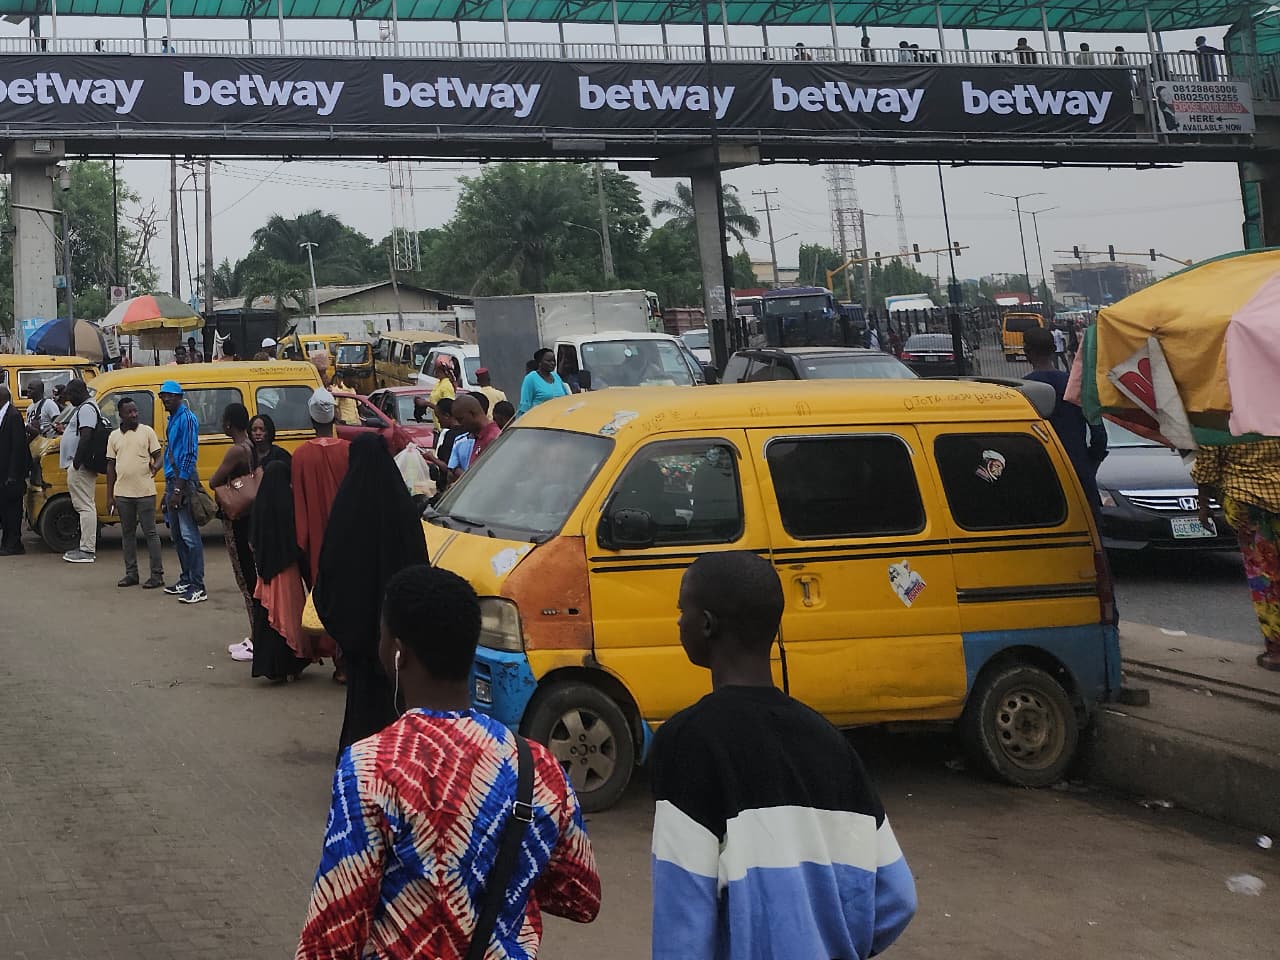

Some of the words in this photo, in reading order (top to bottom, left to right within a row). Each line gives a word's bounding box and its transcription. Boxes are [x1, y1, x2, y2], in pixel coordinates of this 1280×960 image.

[183, 72, 344, 115] betway
[383, 74, 540, 117] betway
[578, 76, 735, 119] betway
[772, 79, 924, 122] betway
[962, 82, 1112, 124] betway
[1225, 124, 1242, 132] NOW
